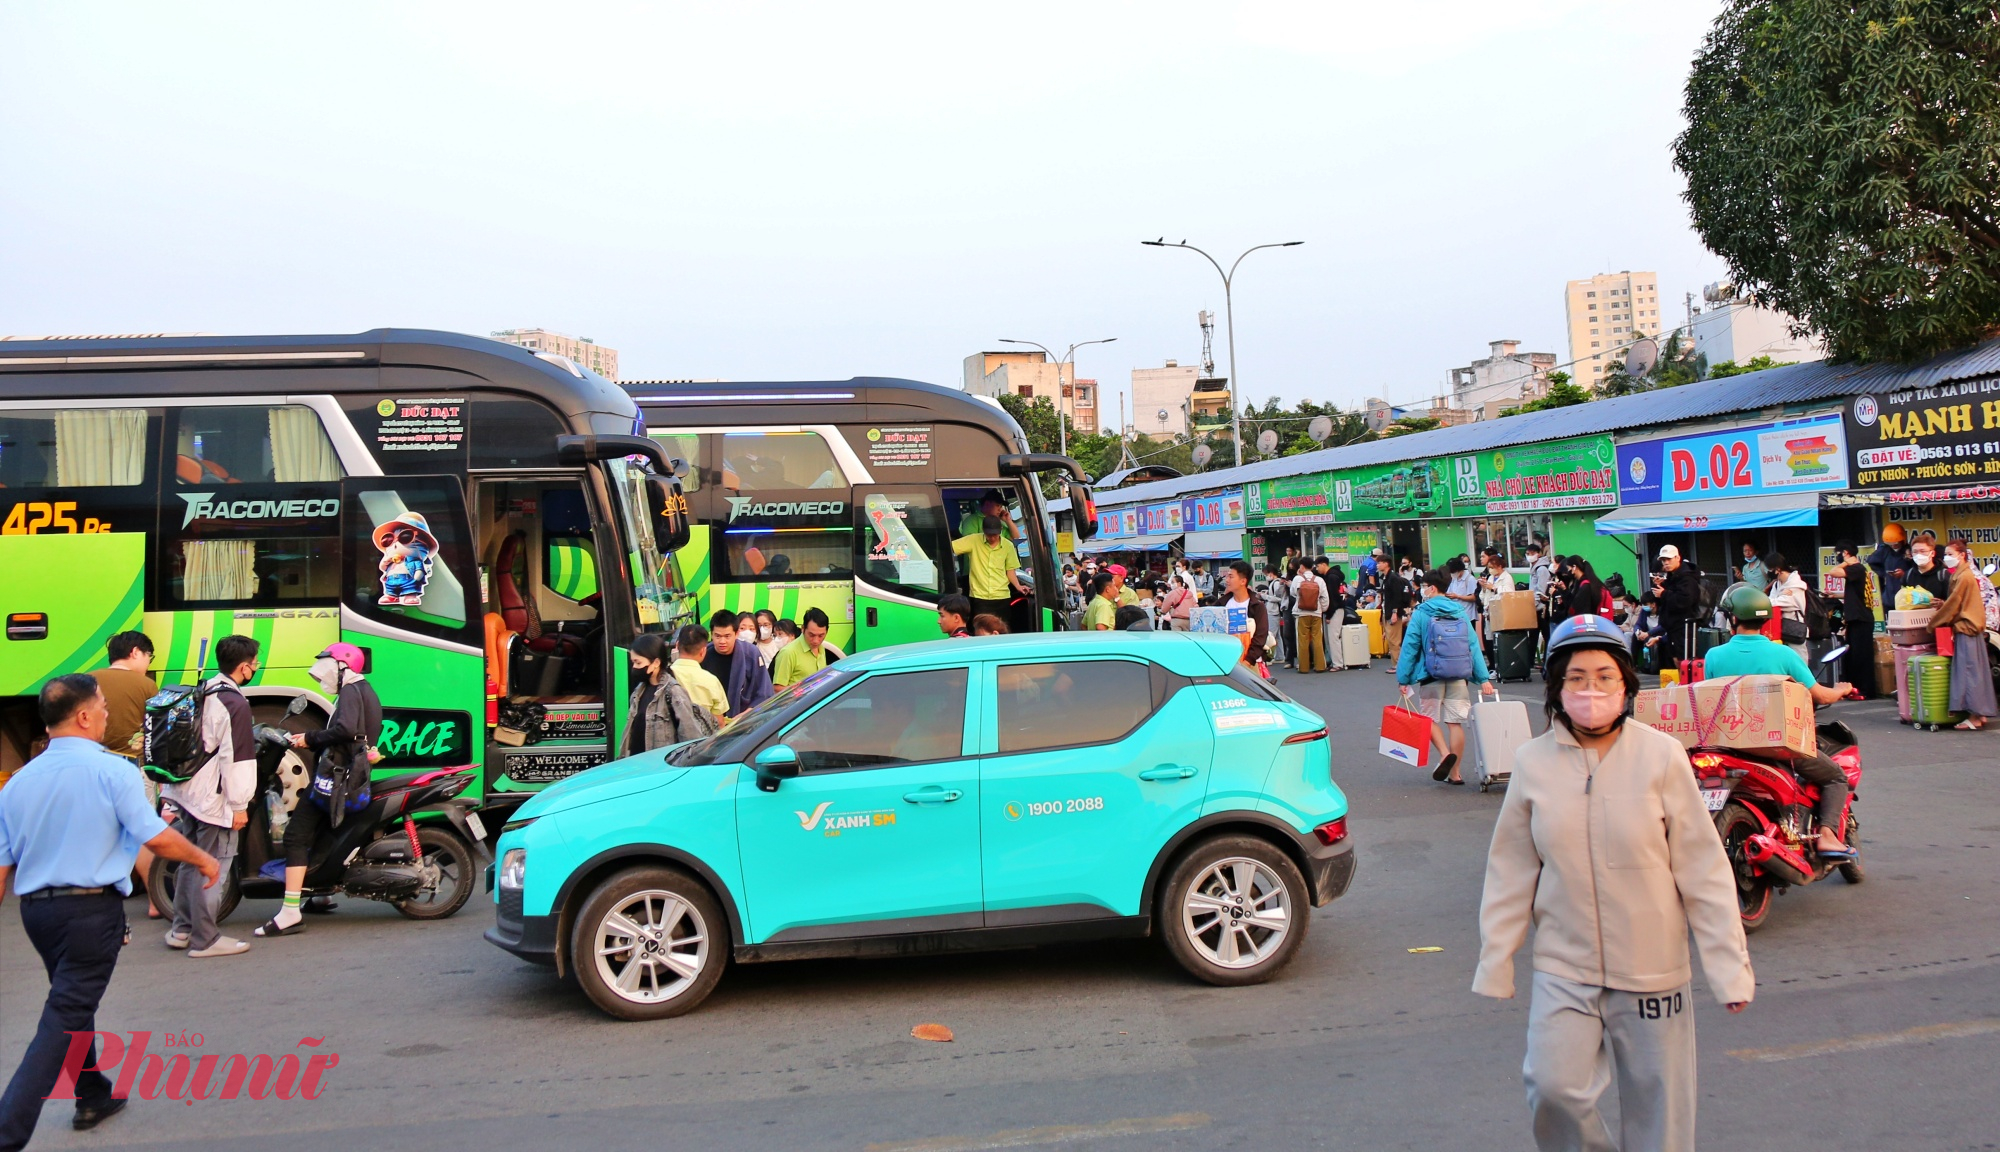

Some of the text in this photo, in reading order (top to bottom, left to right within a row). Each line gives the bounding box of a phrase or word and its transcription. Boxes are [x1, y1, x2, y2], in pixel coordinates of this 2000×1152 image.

[1889, 392, 1913, 406] HỢP
[1941, 382, 1958, 398] XÃ
[1960, 381, 1977, 396] DU
[1878, 403, 1974, 445] MẠNH
[1872, 448, 1917, 465] ĐẶT VÉ:
[1921, 447, 1952, 459] 0563
[1955, 444, 1980, 457] 613
[1461, 457, 1472, 475] D
[1670, 440, 1753, 493] D.02
[1858, 471, 1878, 485] QUY
[1881, 467, 1909, 481] NHƠN
[1916, 462, 1952, 478] PHƯỚC
[1954, 461, 1976, 475] SƠN
[1250, 484, 1258, 497] D
[1339, 480, 1347, 495] D
[1458, 475, 1478, 494] 03
[1485, 474, 1505, 499] NHÀ
[1523, 476, 1536, 495] XE
[1536, 469, 1568, 494] KHÁCH
[1569, 466, 1590, 492] ĐỨC
[1590, 468, 1612, 494] ĐẠT
[1249, 497, 1261, 511] 05
[1337, 497, 1351, 510] 04
[1889, 489, 1951, 505] MẠNH
[2, 501, 77, 535] 425
[175, 492, 340, 531] TRACOMECO
[723, 496, 844, 525] TRACOMECO
[1147, 509, 1165, 531] D.07
[1197, 502, 1220, 526] D.06
[1103, 515, 1119, 534] D.08
[1683, 516, 1709, 528] D.02
[1210, 698, 1247, 710] 11366C
[144, 731, 153, 762] YONEX
[535, 754, 589, 765] WELCOME
[1027, 796, 1104, 816] 1900 2088
[824, 813, 896, 830] XANH SM
[824, 829, 841, 838] CAR
[1637, 992, 1683, 1020] 1970
